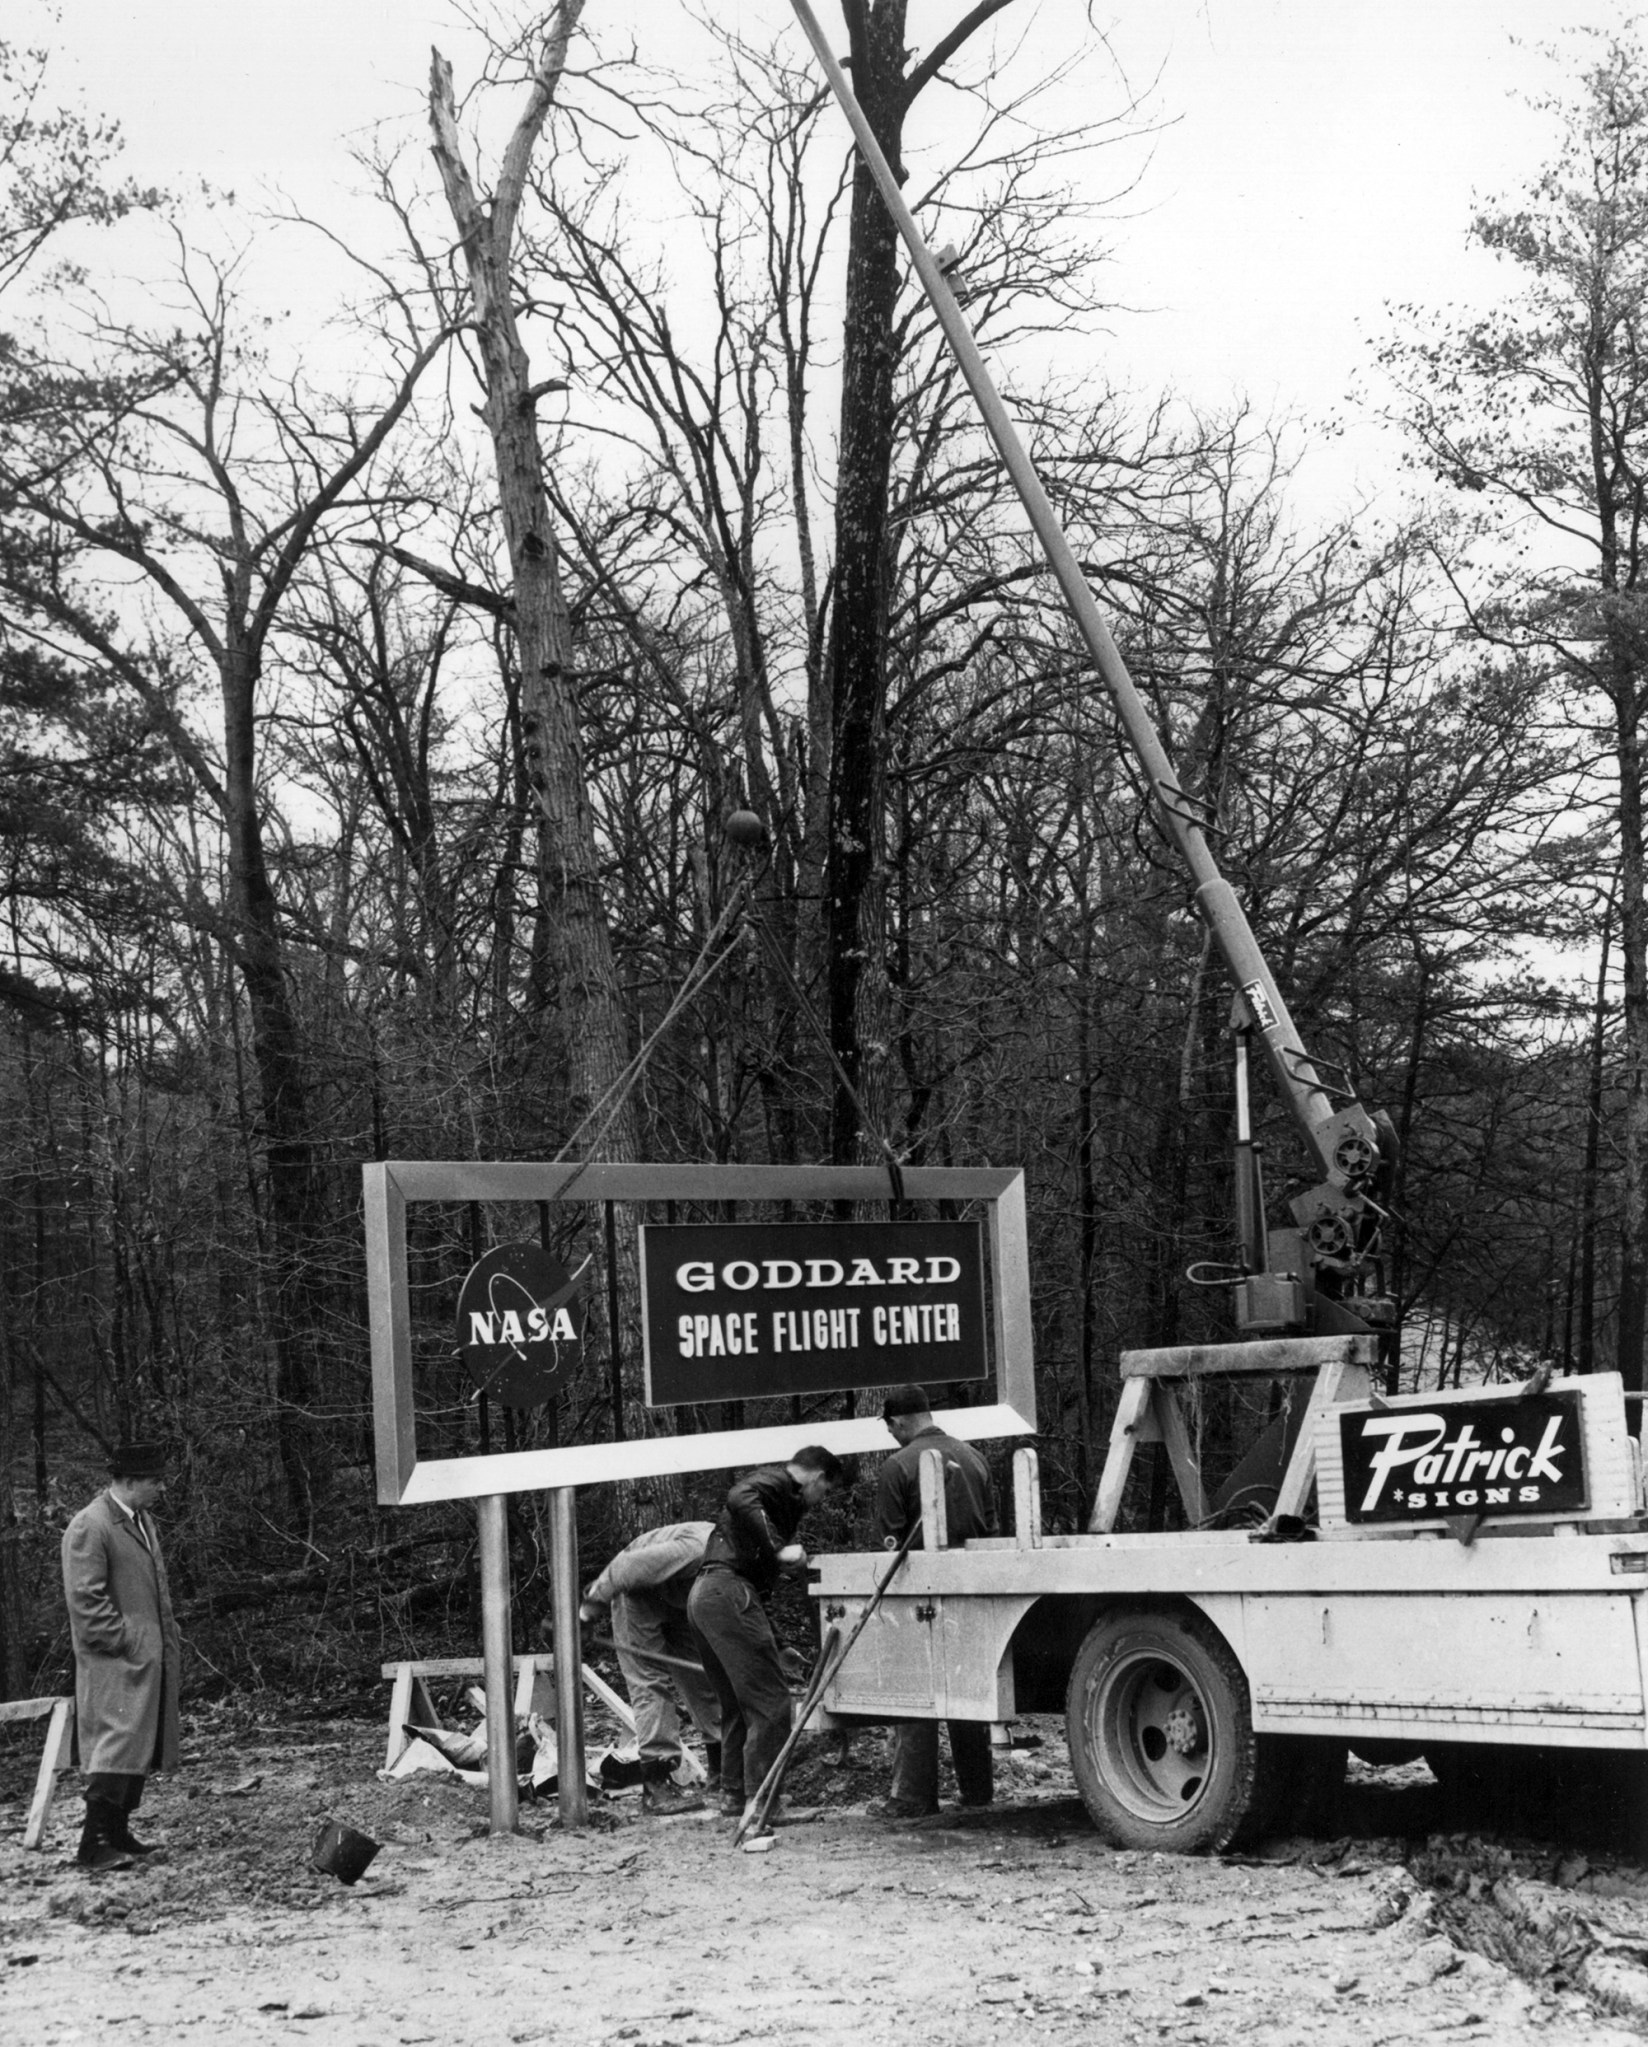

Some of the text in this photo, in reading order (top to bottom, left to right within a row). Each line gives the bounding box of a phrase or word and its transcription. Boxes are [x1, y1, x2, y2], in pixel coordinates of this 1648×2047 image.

[675, 1256, 962, 1292] GODDARD
[469, 1307, 577, 1345] NASA
[678, 1303, 961, 1358] SPACE FLIGHT CENTER
[1360, 1412, 1566, 1511] Patrick
